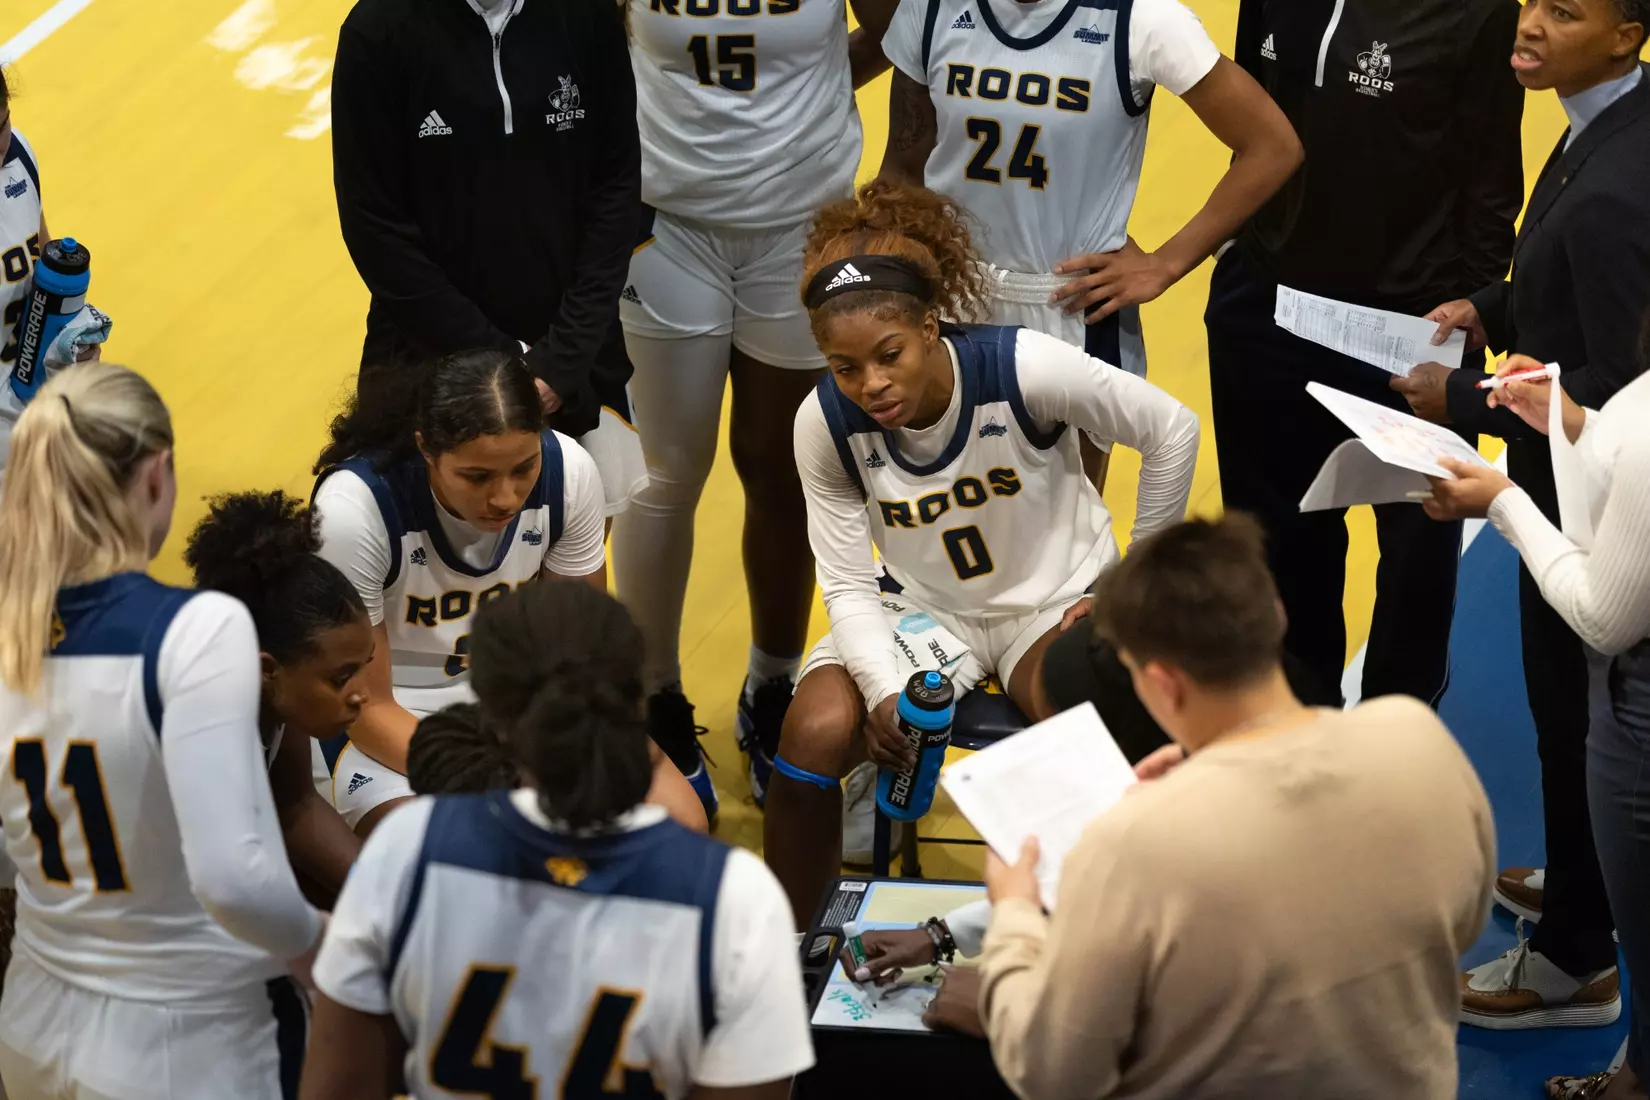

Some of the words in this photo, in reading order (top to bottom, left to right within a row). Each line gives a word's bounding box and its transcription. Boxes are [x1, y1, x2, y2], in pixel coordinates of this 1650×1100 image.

[951, 22, 976, 30] adidas
[1073, 30, 1110, 42] SUMMIT
[686, 34, 757, 92] 15
[946, 62, 1092, 113] ROOS
[1348, 70, 1395, 92] ROOS
[418, 126, 453, 138] adidas
[545, 109, 586, 125] ROOS
[964, 115, 1050, 192] 24
[825, 274, 872, 292] adidas
[16, 290, 48, 384] POWERADE
[876, 465, 1023, 529] ROOS
[941, 524, 995, 581] 0
[405, 580, 530, 629] RO
[347, 776, 374, 796] adidas
[891, 725, 923, 806] PORADE
[10, 737, 133, 893] 11
[428, 962, 656, 1100] 44
